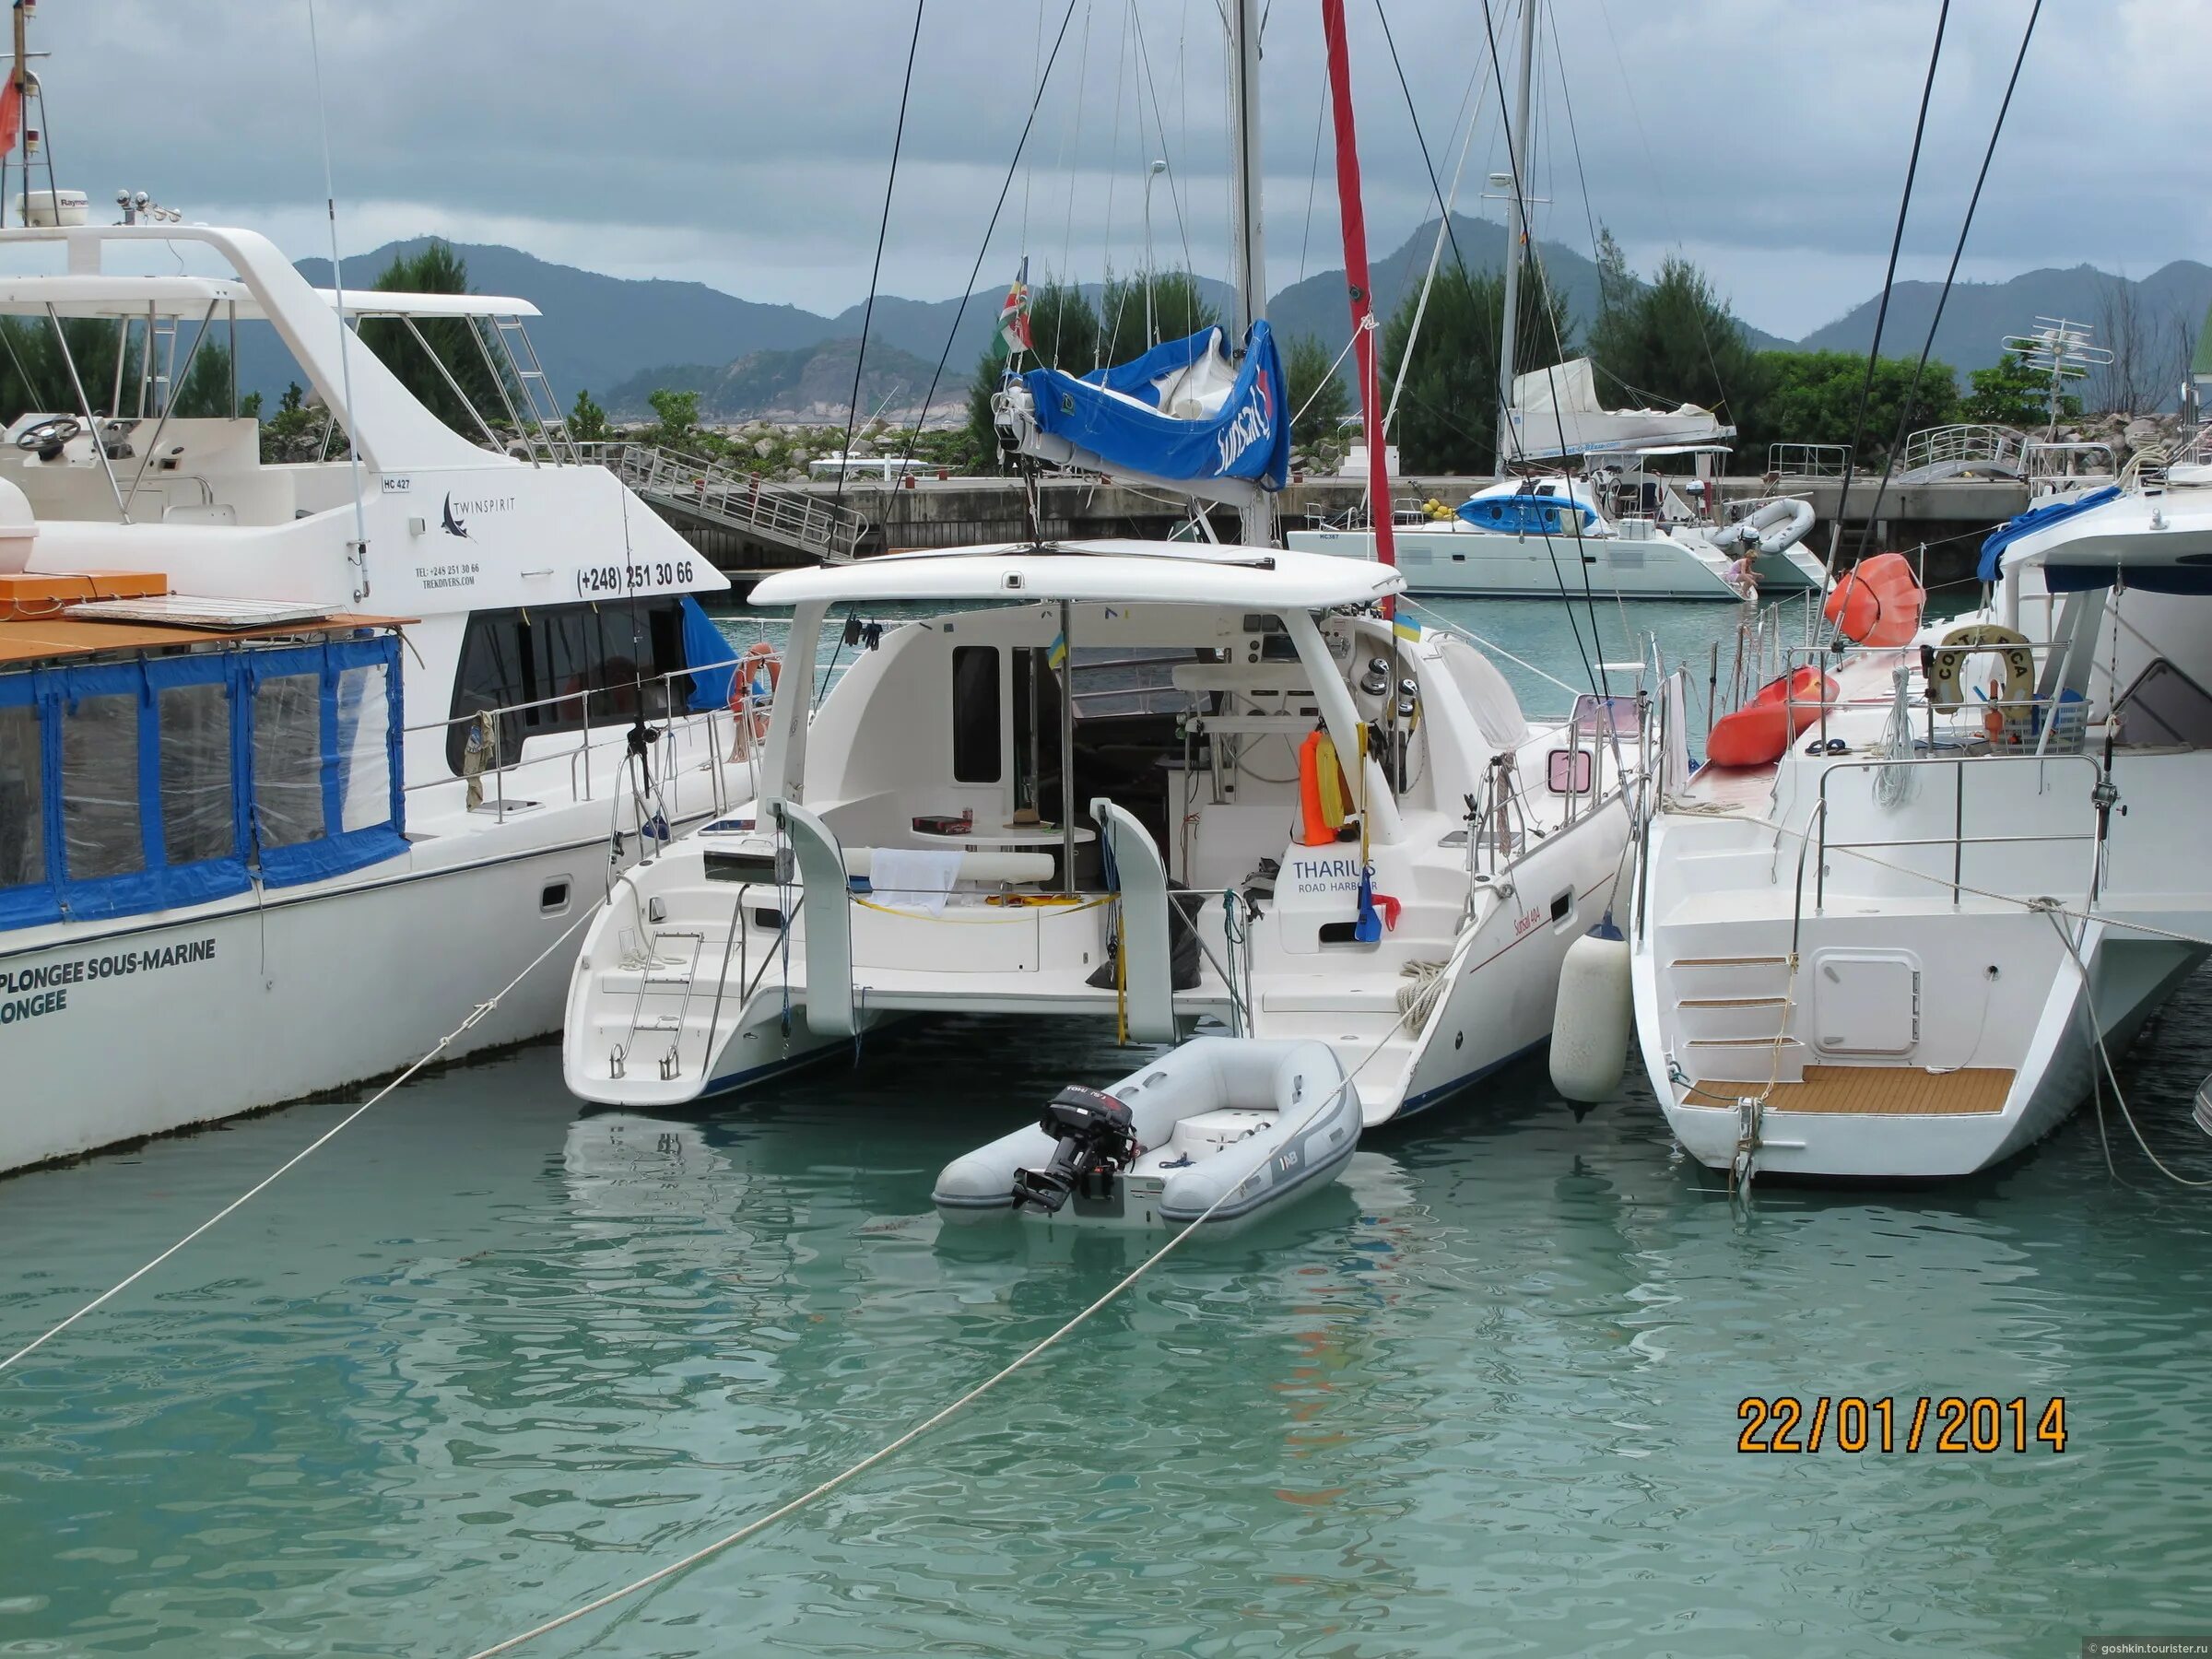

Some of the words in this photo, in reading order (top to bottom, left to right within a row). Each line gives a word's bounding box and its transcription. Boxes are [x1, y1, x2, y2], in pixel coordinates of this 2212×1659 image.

[383, 479, 395, 489] HC
[396, 479, 410, 489] 427
[453, 498, 516, 516] TWINSPIRIT
[415, 568, 429, 578] TEL:
[447, 565, 460, 575] 251
[462, 564, 470, 574] 30
[471, 563, 480, 573] 66
[577, 566, 622, 598] (+248)
[626, 564, 651, 588] 251
[655, 562, 673, 586] 30
[677, 560, 694, 584] 66
[422, 576, 476, 590] TREKDIVERS.COM
[1292, 859, 1376, 879] THARIUS
[1298, 883, 1326, 893] ROAD
[1330, 881, 1378, 892] HARBR
[0, 960, 85, 994] PLONGEE
[88, 938, 217, 981] SOUS-MARINE
[0, 989, 67, 1025] ONGEE
